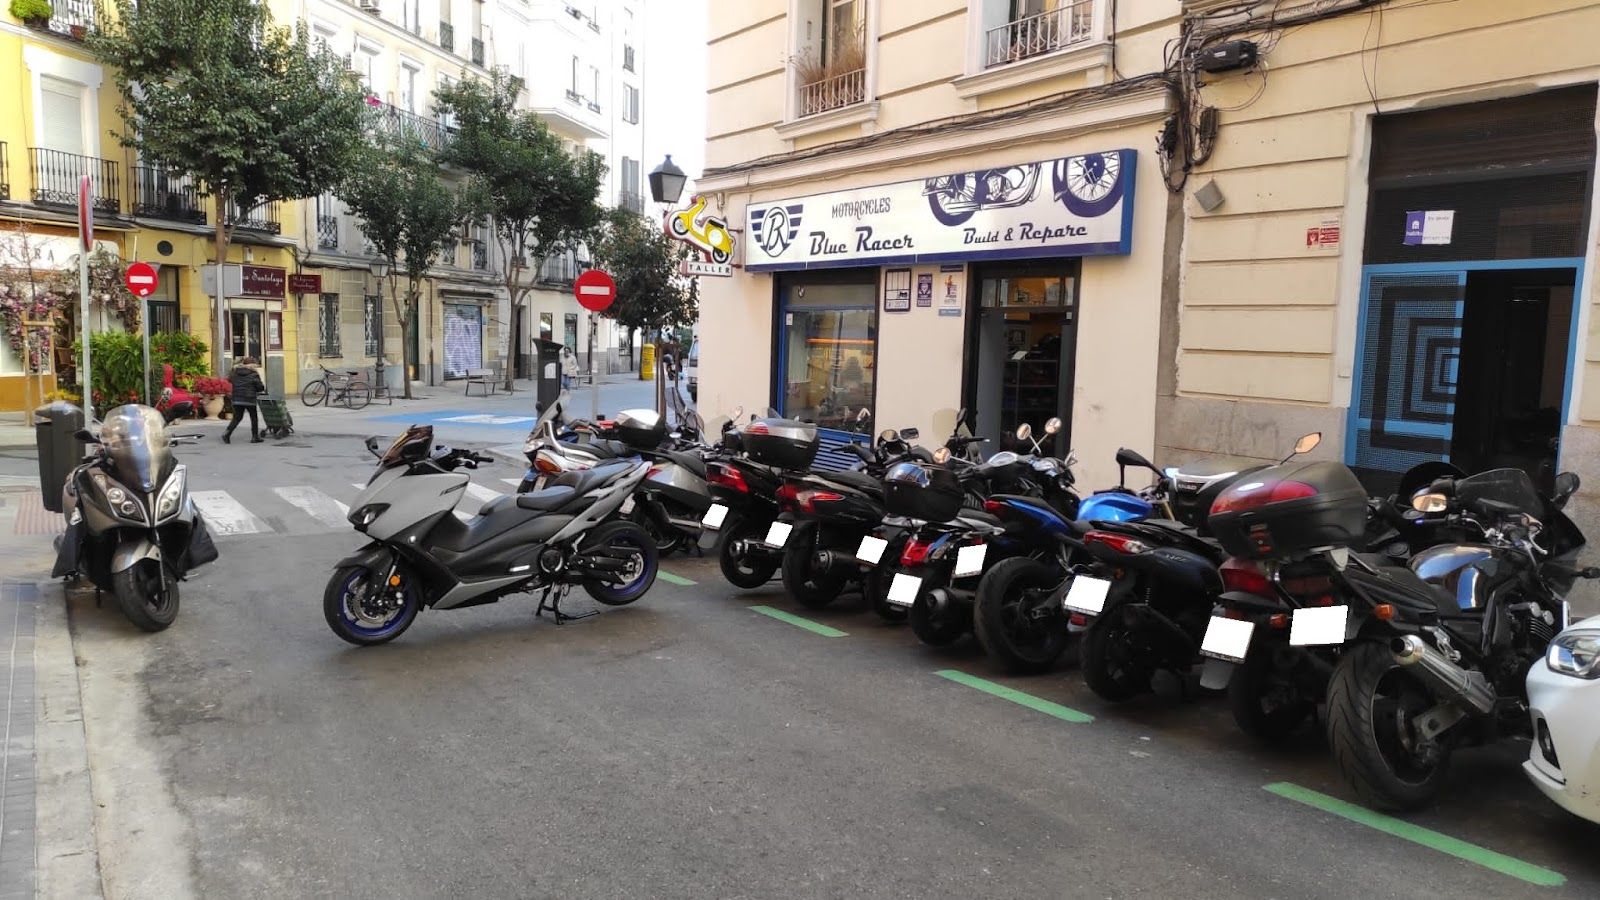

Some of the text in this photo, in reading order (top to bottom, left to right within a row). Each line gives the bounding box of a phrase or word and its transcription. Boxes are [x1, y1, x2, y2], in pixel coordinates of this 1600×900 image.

[832, 197, 891, 220] MOTORCYCLES
[809, 225, 914, 256] Blue Racer
[963, 222, 1088, 245] Build & Repare
[689, 264, 731, 274] TALLER
